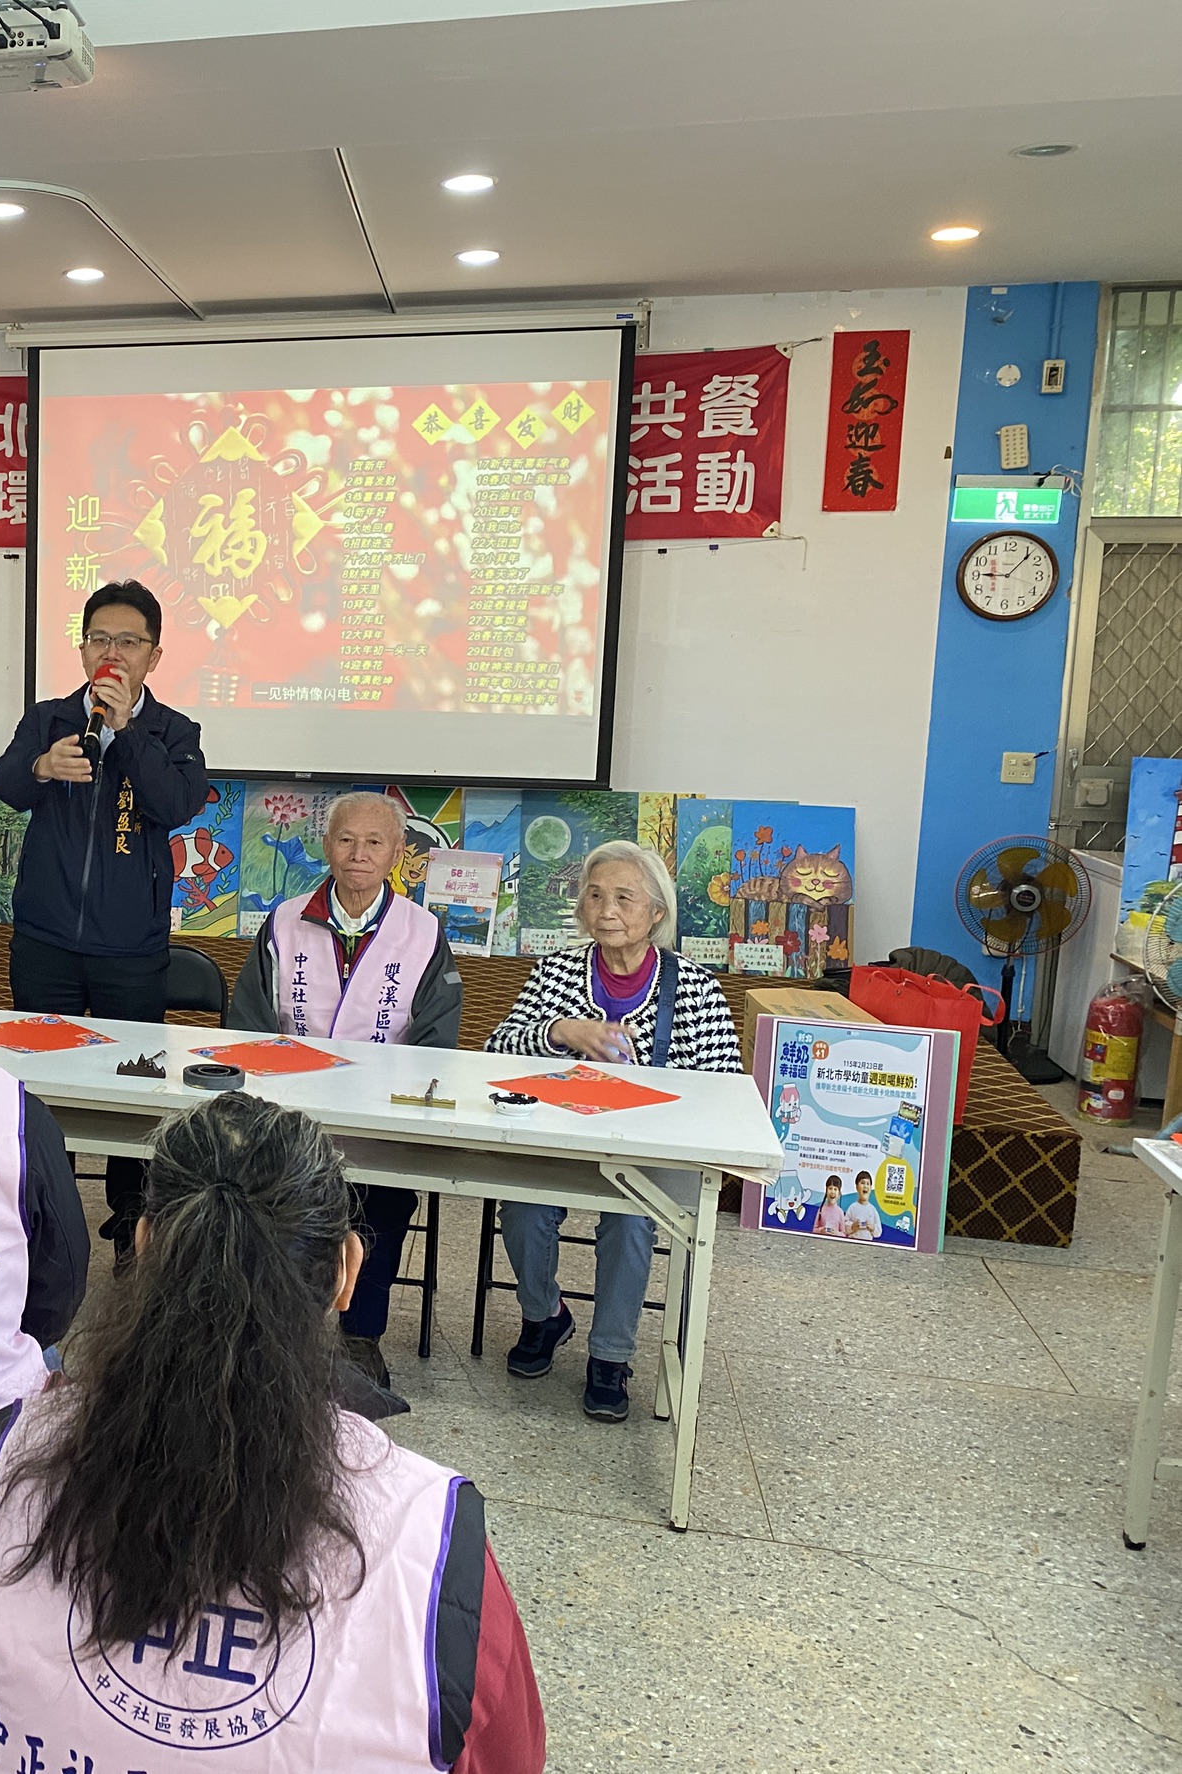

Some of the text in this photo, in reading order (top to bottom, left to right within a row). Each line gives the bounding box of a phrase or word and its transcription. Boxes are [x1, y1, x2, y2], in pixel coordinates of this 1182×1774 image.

[630, 374, 760, 443] 共餐
[626, 449, 756, 515] 活動
[190, 488, 267, 580] 福
[988, 545, 998, 555] 11
[1003, 541, 1018, 552] 12
[975, 556, 987, 567] 10
[1033, 556, 1042, 566] 2
[972, 570, 980, 581] 9
[1035, 571, 1044, 581] 3
[974, 584, 983, 595] 8
[1028, 586, 1037, 596] 4
[985, 596, 993, 606] 7
[1000, 599, 1009, 610] 6
[1017, 596, 1025, 606] 5
[254, 686, 352, 701] 一见钟情像闪电
[780, 1041, 809, 1064] 鮮奶
[815, 1049, 826, 1059] +1
[94, 1672, 269, 1740] 中正社區發展協會
